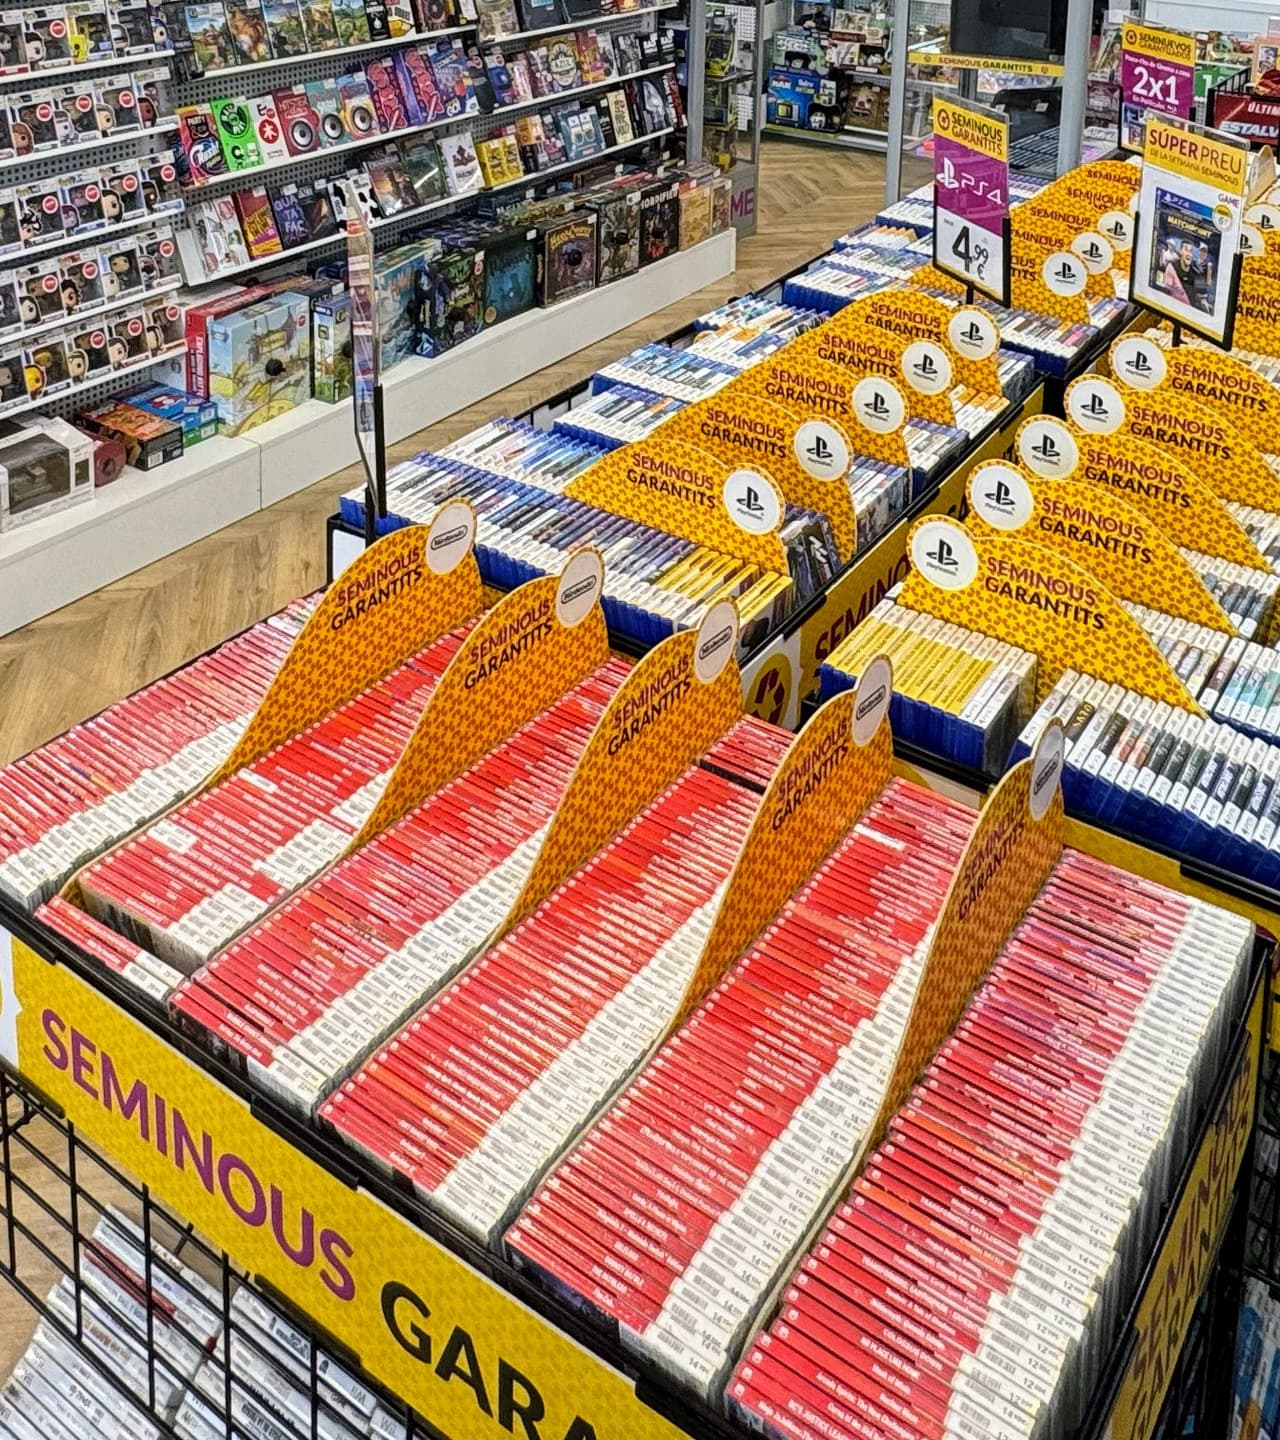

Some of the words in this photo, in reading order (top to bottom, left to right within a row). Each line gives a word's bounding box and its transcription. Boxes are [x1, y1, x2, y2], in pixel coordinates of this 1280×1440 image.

[1138, 31, 1191, 54] SEMINUEVOS
[938, 57, 981, 68] SEMINOUS
[982, 61, 1033, 72] GARANTITS
[1132, 66, 1179, 106] 2x1
[1247, 101, 1280, 115] ÚLTIM
[951, 111, 1003, 142] SEMINOUS
[951, 126, 1003, 155] GARANTITS
[1220, 120, 1279, 138] ESTALV
[1149, 128, 1199, 160] SÚPER
[1200, 145, 1242, 176] PREU
[960, 172, 1002, 205] PS4
[1086, 170, 1141, 187] SEMINOU
[730, 186, 755, 216] ME
[1031, 207, 1091, 226] SEMINOUS
[1218, 193, 1240, 209] GAME
[1010, 229, 1064, 249] MINOUS
[865, 315, 942, 344] GARANTITS
[871, 302, 941, 328] SEMINOUS
[817, 347, 897, 378] GARANTITS
[823, 333, 896, 362] SEMINOUS
[770, 368, 847, 399] SEMINOUS
[1172, 377, 1267, 413] GARANTITS
[1174, 362, 1260, 393] SEMINOUS
[765, 383, 848, 415] GARANTITS
[701, 422, 787, 458] GARANTITS
[706, 407, 786, 441] SEMINOUS
[1132, 405, 1224, 440] SEMINOUS
[1129, 421, 1231, 460] GARANTITS
[631, 452, 714, 490] SEMINOUS
[1086, 449, 1185, 489] SEMINOUS
[626, 469, 716, 509] GARANTITS
[1084, 466, 1192, 508] GARANTITS
[1041, 497, 1145, 542] SEMINOUS
[434, 529, 465, 547] Nintendo
[1039, 515, 1152, 564] GARANTITS
[337, 546, 420, 603] SEMINOUS
[564, 581, 595, 601] Nintendo
[987, 556, 1097, 607] SEMINOUS
[331, 564, 422, 631] GARANTITS
[815, 553, 911, 660] SEMINO
[985, 575, 1105, 631] GARANTITS
[471, 599, 550, 661] SEMINOUS
[702, 630, 732, 656] Nintendo
[464, 618, 553, 690] GARANTITS
[613, 657, 689, 728] SEMINOUS
[857, 689, 885, 717] Nintendo
[608, 675, 691, 756] GARANTITS
[778, 717, 847, 799] SEMINOUS
[773, 742, 849, 830] GARANTITS
[958, 823, 1025, 920] GARANTITS
[41, 1007, 357, 1301] SEMINOUS
